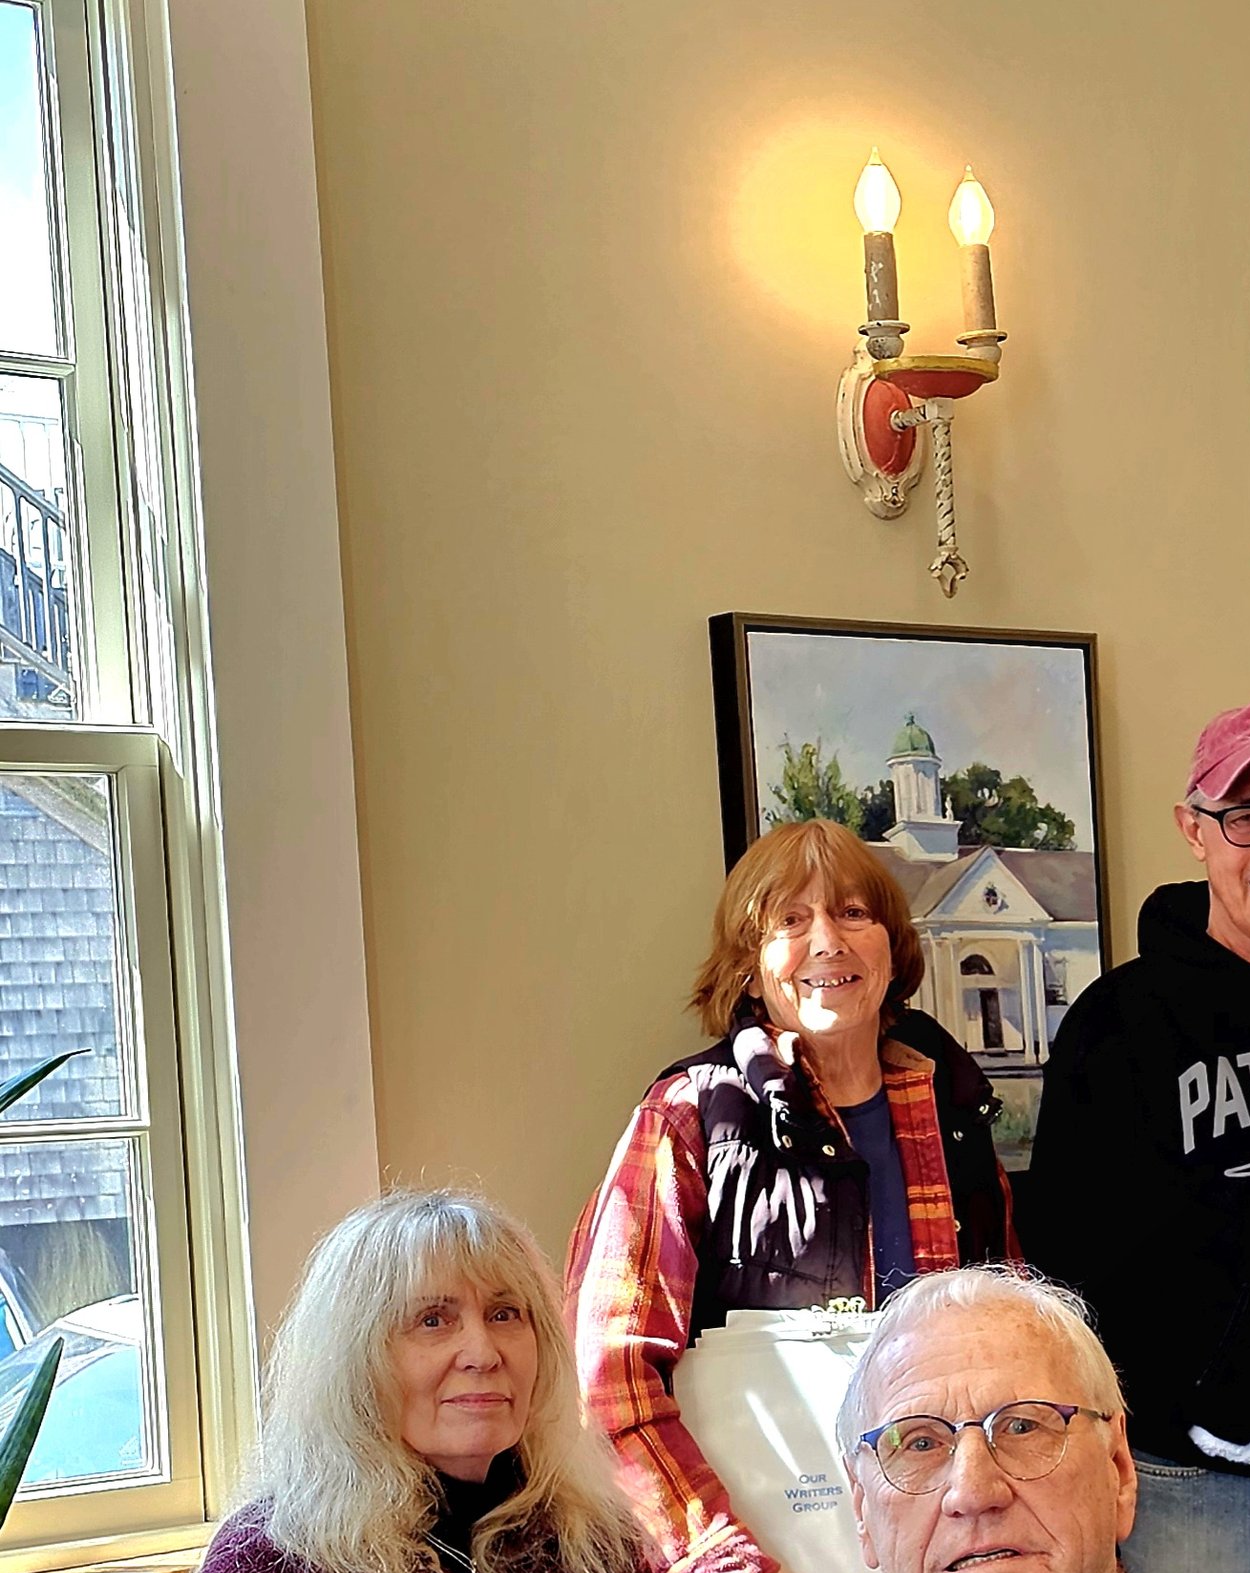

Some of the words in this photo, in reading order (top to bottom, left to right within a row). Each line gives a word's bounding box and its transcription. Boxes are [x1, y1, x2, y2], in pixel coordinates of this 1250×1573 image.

[799, 1474, 827, 1484] OUR
[784, 1486, 843, 1499] WRITERS
[792, 1501, 838, 1513] GROUP
